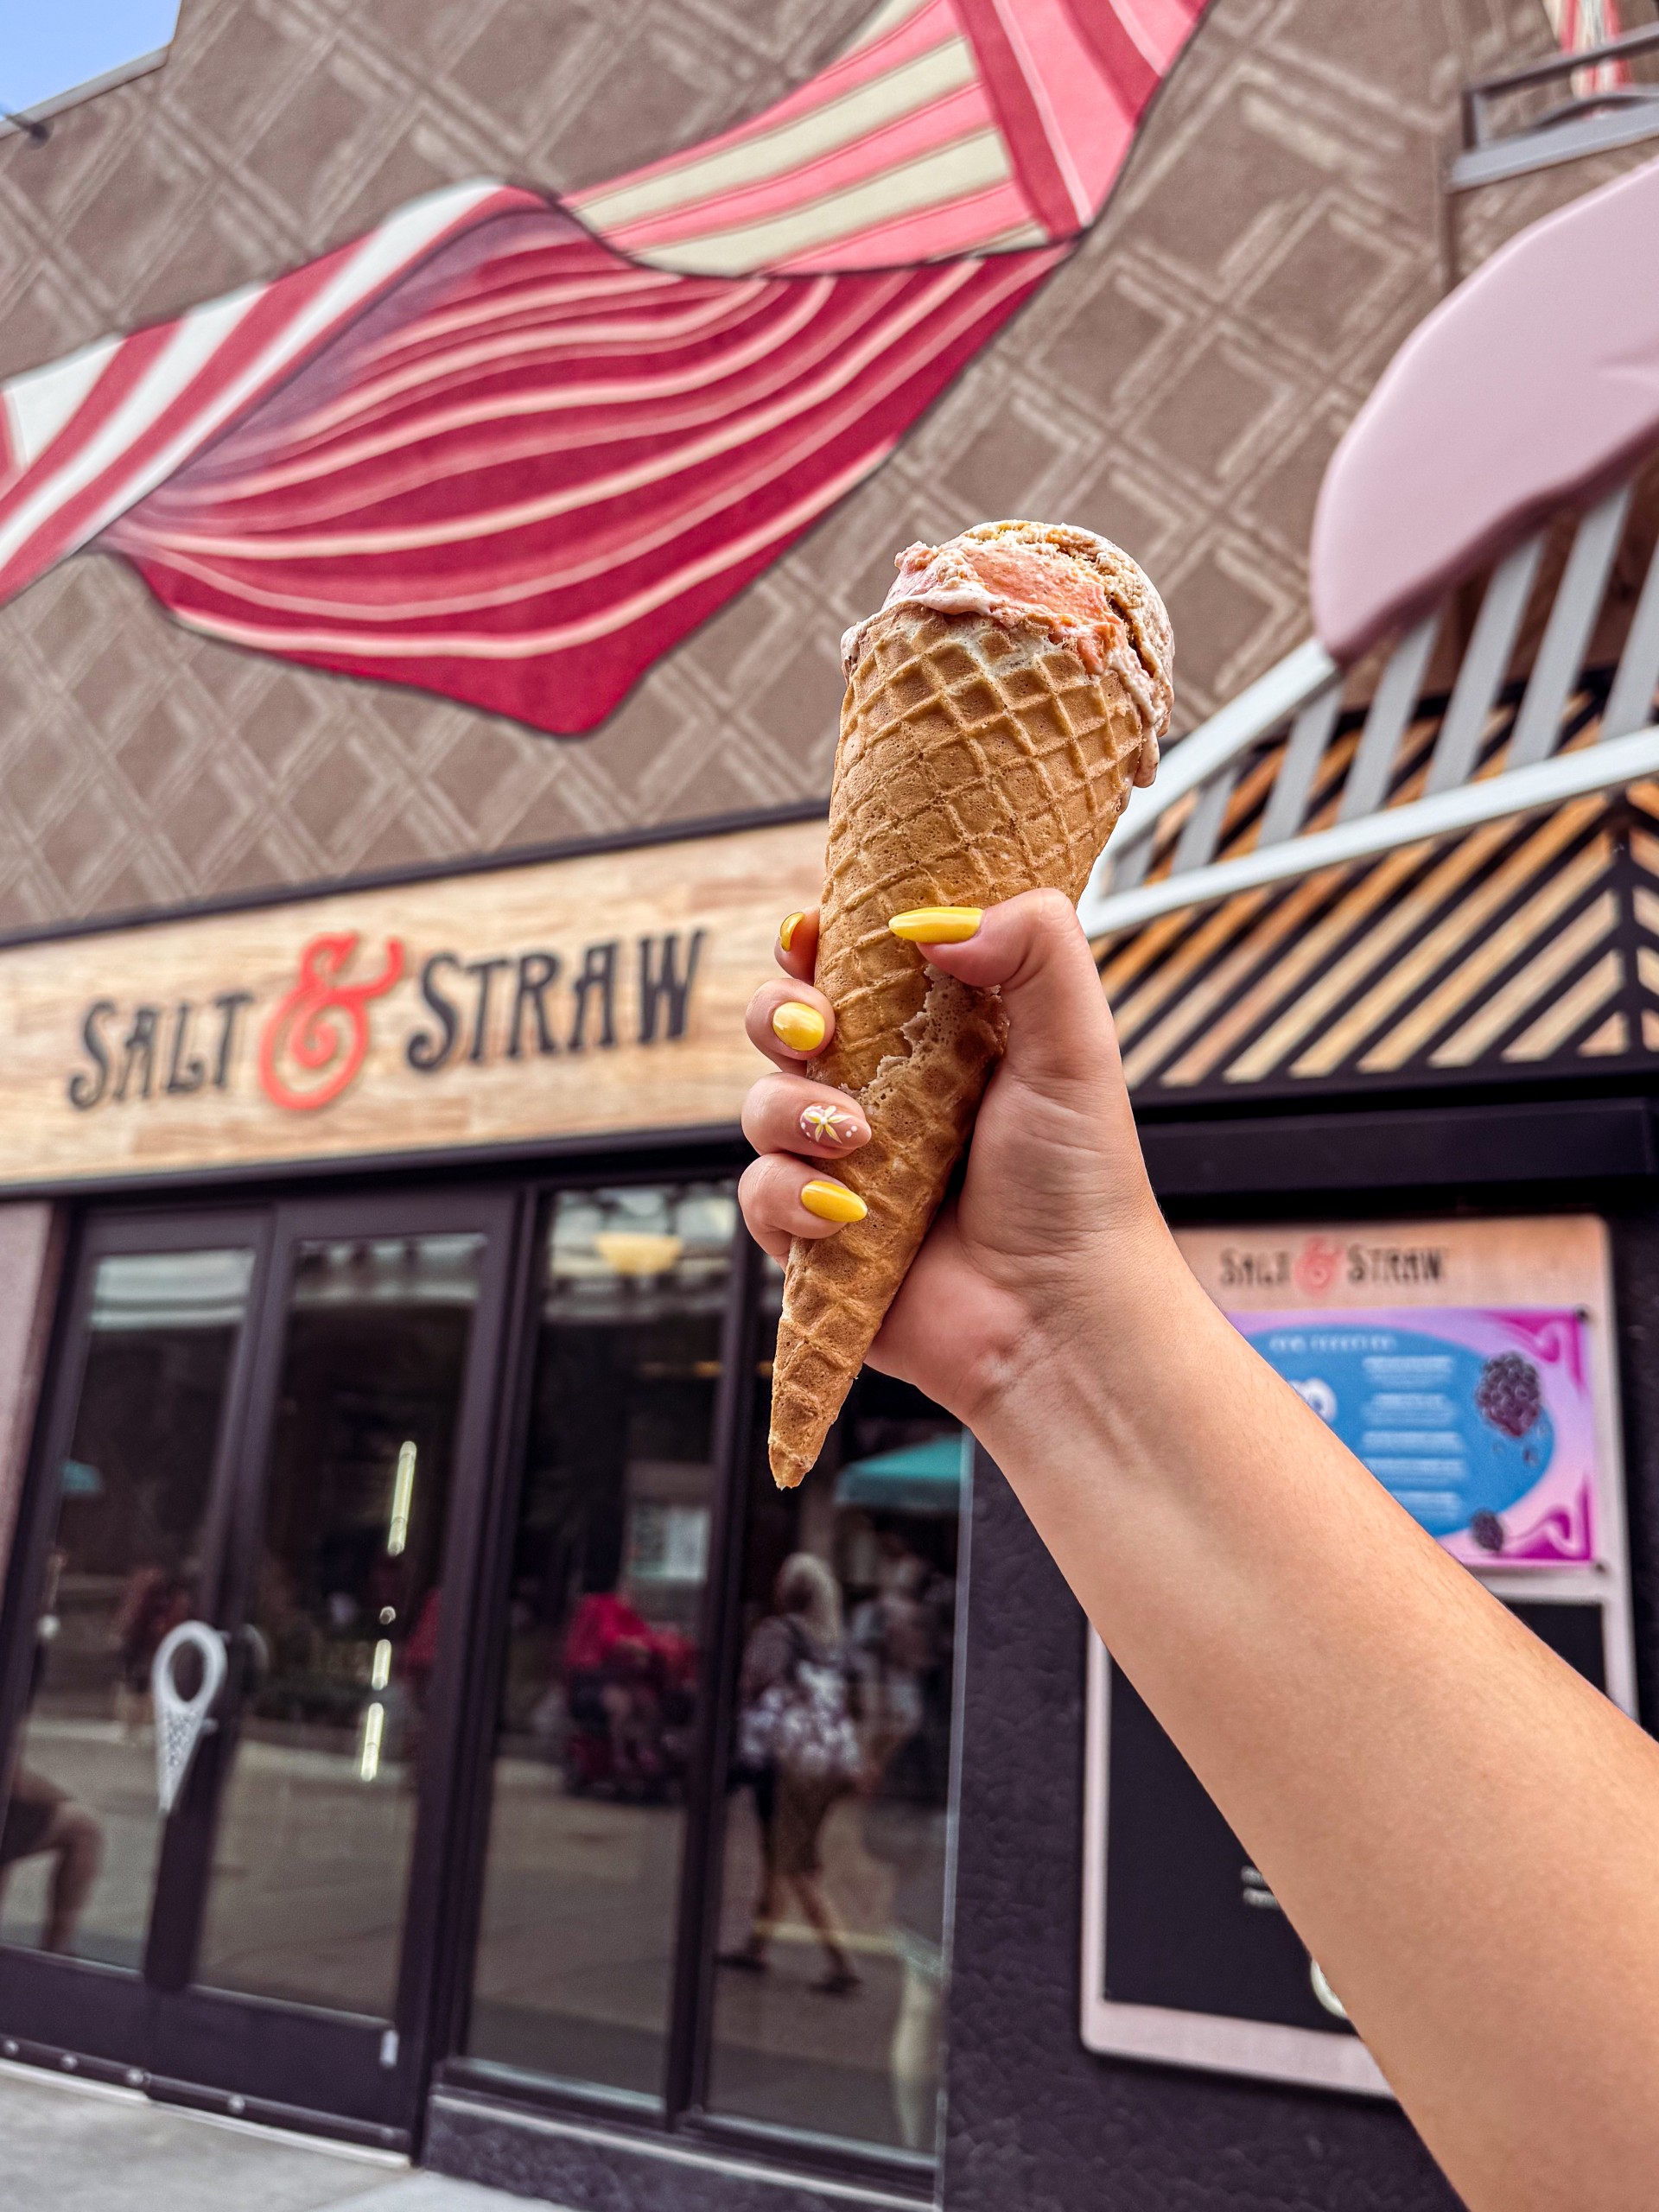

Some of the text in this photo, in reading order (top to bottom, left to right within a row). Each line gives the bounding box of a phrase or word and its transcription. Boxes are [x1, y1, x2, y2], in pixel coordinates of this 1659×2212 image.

[68, 928, 707, 1112] SALT & STRAW
[1294, 1235, 1345, 1296] &
